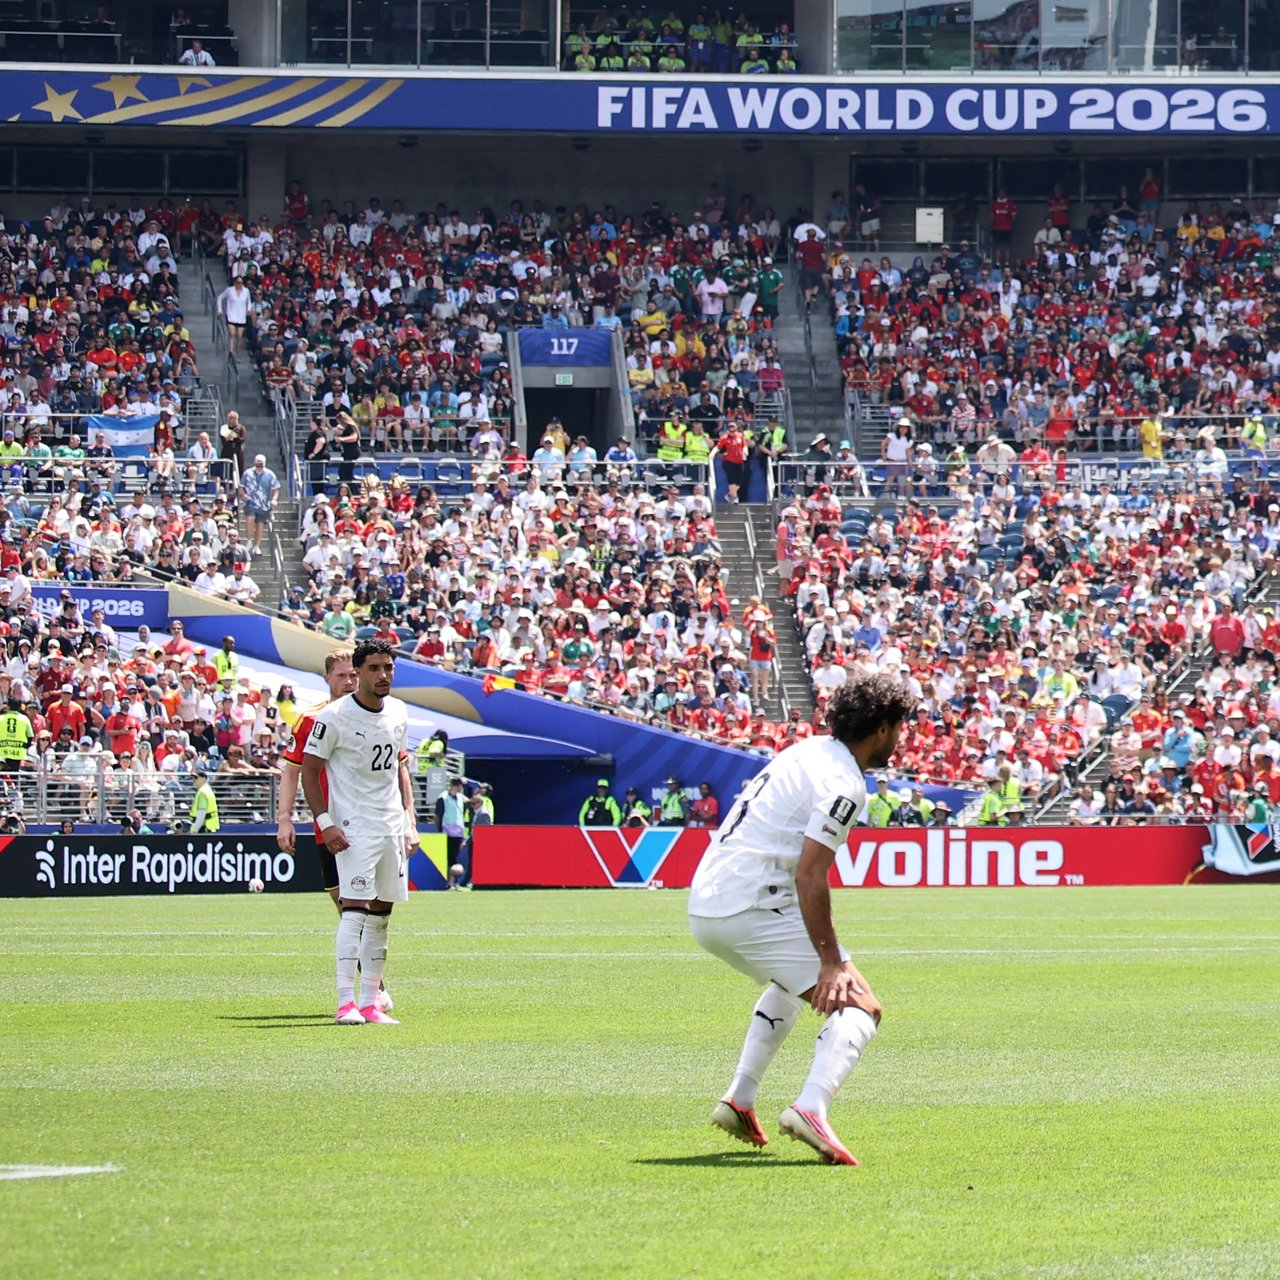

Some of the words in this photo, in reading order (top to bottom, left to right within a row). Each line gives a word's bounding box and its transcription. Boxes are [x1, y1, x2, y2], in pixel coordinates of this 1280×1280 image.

[598, 86, 718, 130] FIFA
[727, 87, 933, 131] WORLD
[945, 88, 1058, 131] CUP
[1069, 89, 1267, 132] 2026
[551, 337, 579, 355] 117
[371, 743, 393, 771] 22
[64, 843, 126, 885] Inter
[132, 841, 296, 893] Rapidísimo
[836, 828, 1065, 887] voline
